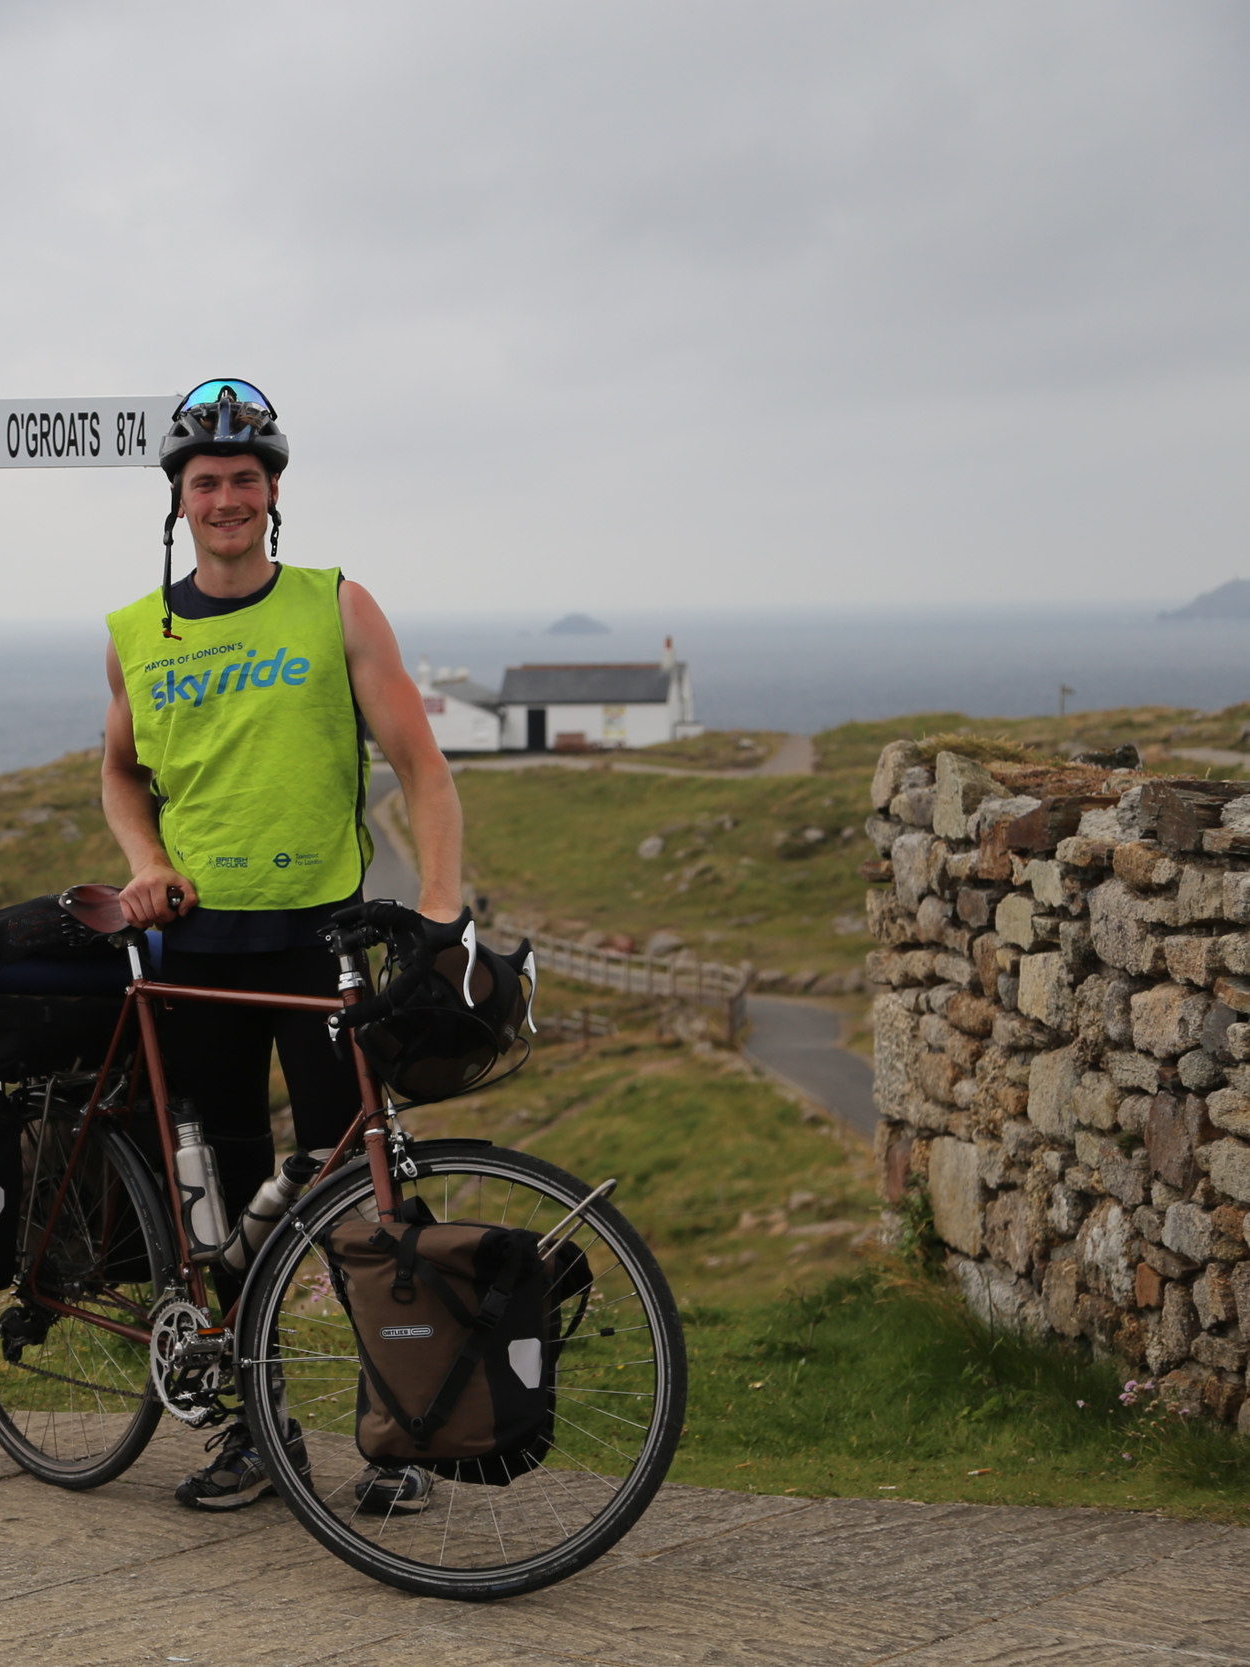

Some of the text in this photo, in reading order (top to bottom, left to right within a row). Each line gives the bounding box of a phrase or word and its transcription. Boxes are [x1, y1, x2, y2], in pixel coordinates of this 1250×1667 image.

[6, 411, 101, 459] O'GROATS
[116, 411, 147, 457] 874
[144, 641, 244, 673] MAYOR OF LONDON'S
[150, 647, 311, 712] sky ride
[295, 852, 319, 860] Transport
